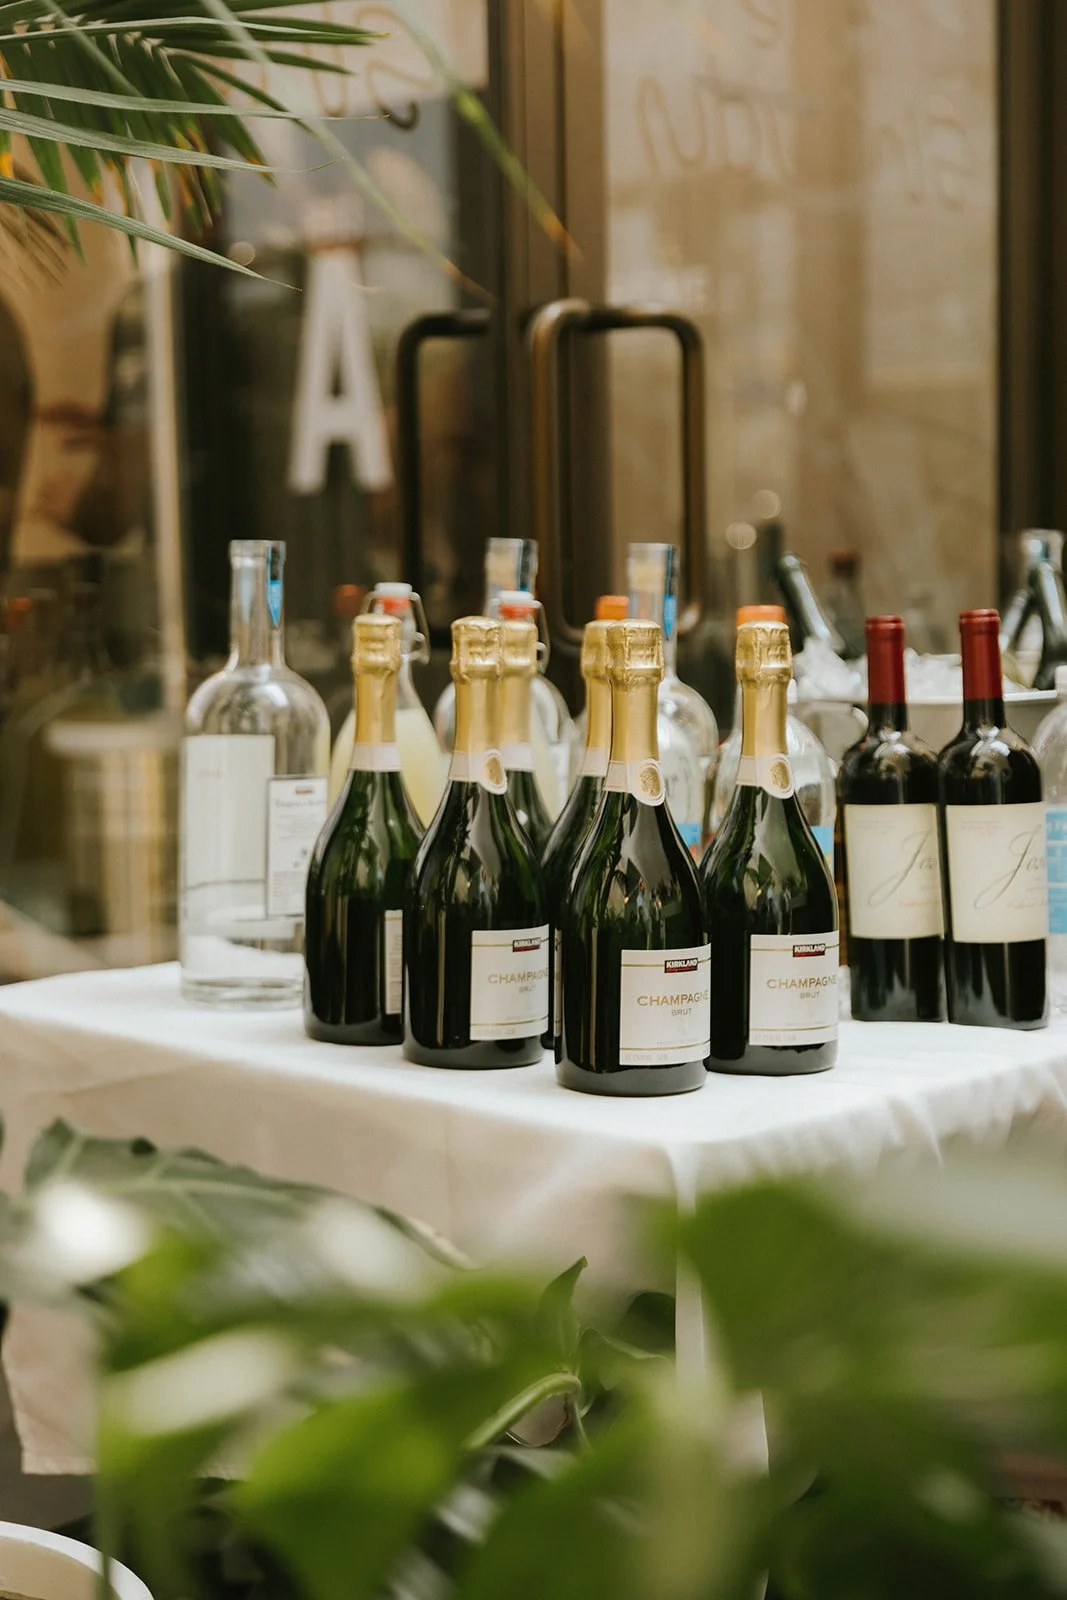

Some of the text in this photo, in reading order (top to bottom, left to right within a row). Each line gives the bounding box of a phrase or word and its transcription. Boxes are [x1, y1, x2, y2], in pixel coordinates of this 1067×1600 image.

[794, 944, 826, 953] KIRKLAND
[666, 958, 698, 969] KIRKLAND
[766, 974, 837, 990] CHAMPAGNE
[518, 984, 537, 994] BRUT
[636, 989, 709, 1007] CHAMPAGNE
[799, 991, 820, 1000] BRUT
[671, 1008, 693, 1017] BRUT
